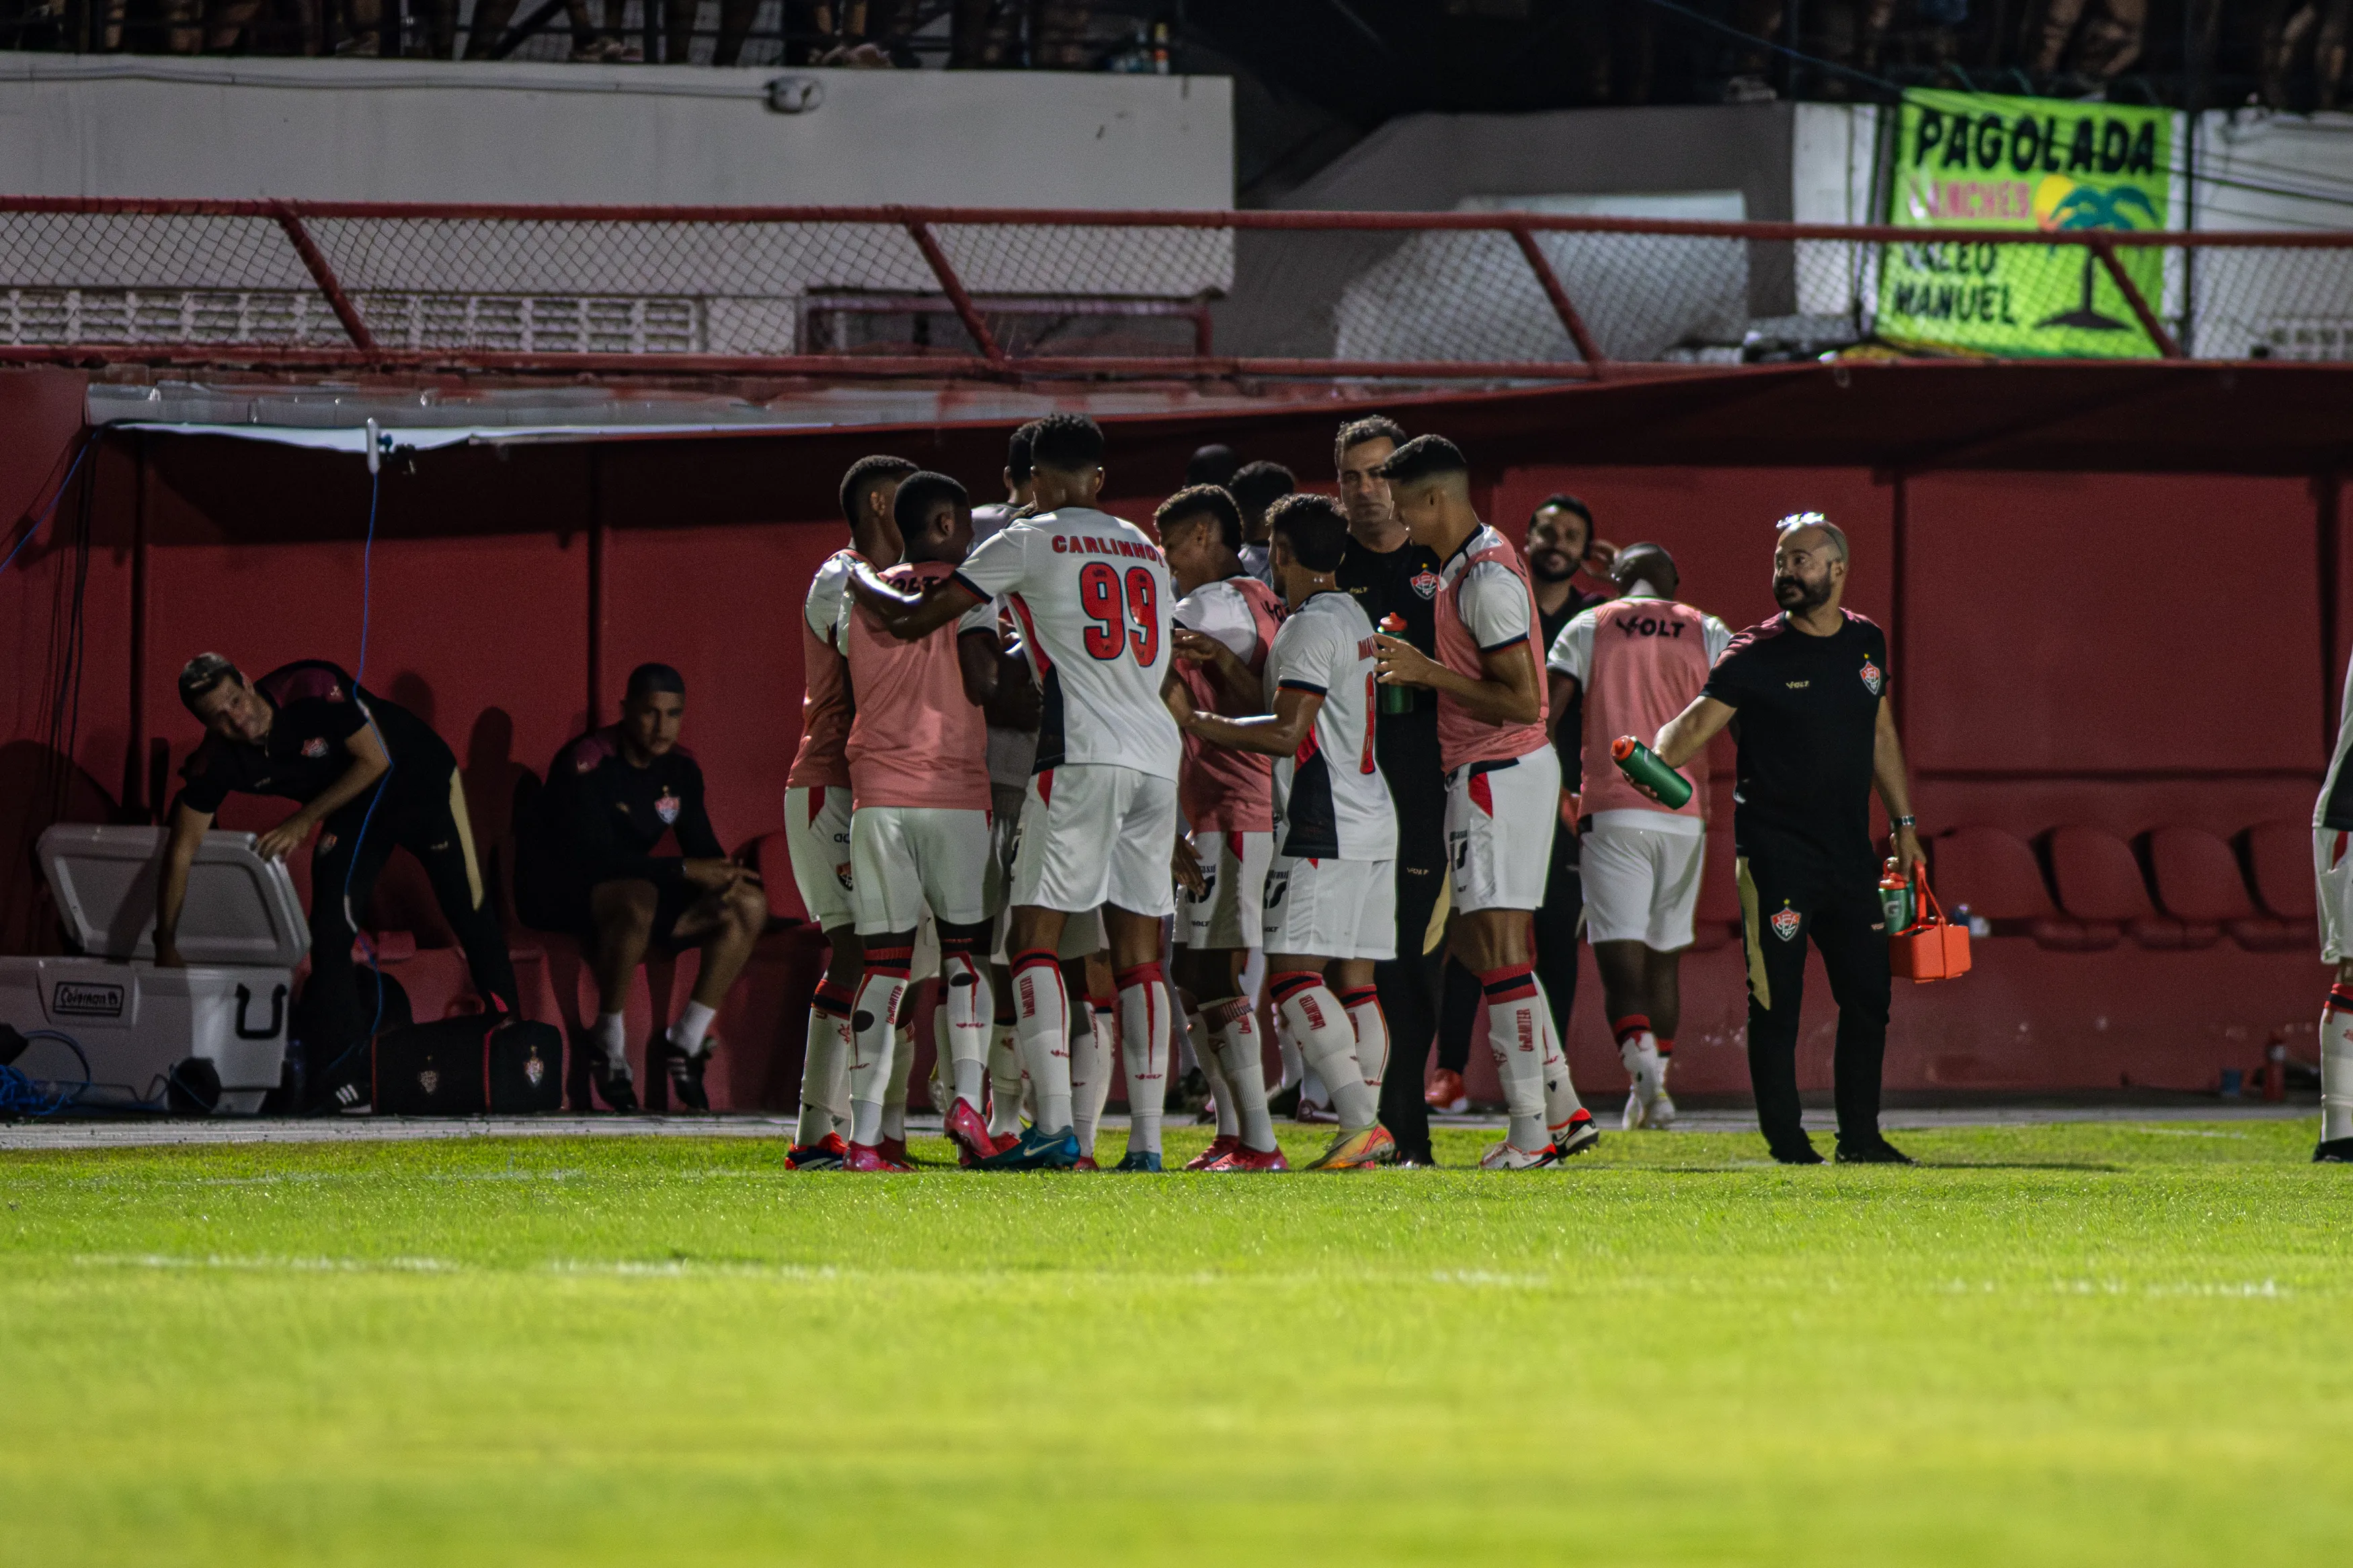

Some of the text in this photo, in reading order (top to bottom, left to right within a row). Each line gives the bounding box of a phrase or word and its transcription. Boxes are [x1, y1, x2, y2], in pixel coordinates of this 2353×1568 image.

[1915, 108, 2156, 175] PAGOLADA
[1080, 562, 1160, 667] 99
[1615, 616, 1685, 638] VOLT
